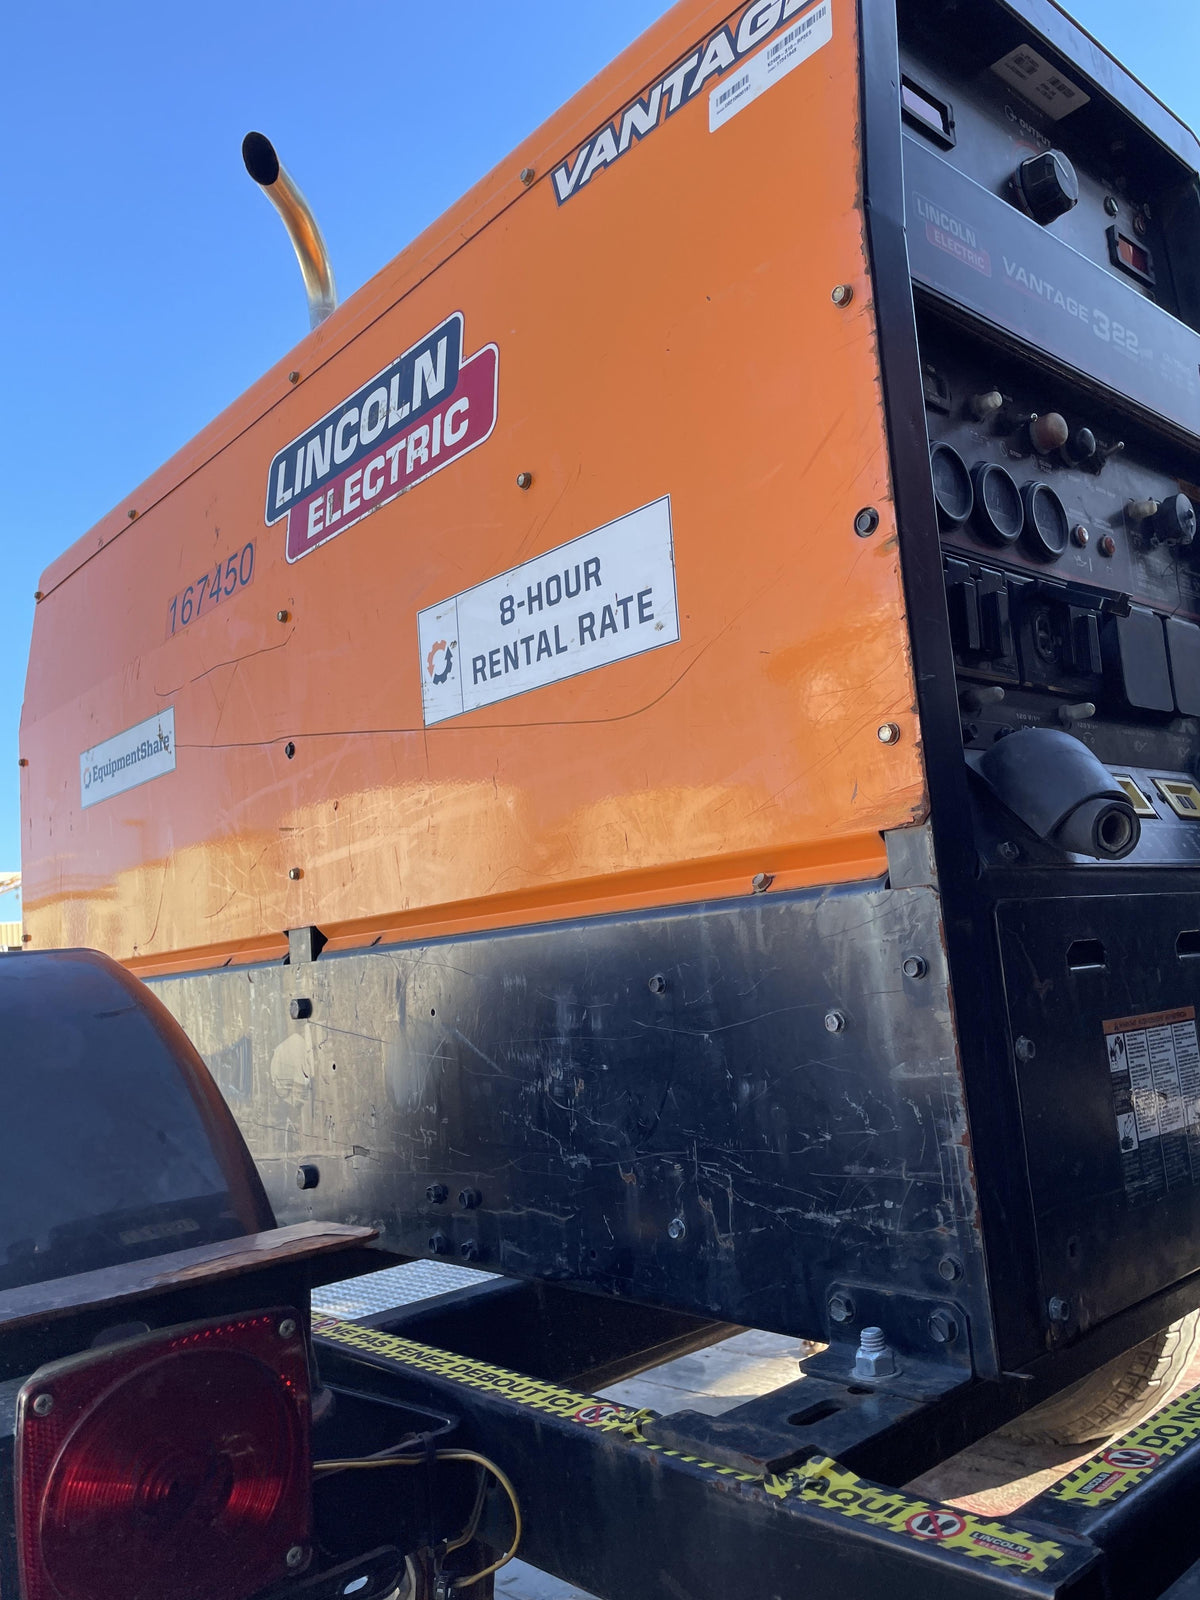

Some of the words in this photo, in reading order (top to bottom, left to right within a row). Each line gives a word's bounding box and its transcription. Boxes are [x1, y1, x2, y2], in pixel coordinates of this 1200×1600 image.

[1019, 118, 1052, 146] OUTPUT
[915, 198, 977, 248] LINCOLN
[934, 231, 985, 269] ELECTRIC
[1002, 255, 1089, 324] VANTAGE
[1092, 308, 1139, 355] 322
[275, 336, 448, 509] LINCOLN
[307, 397, 470, 540] ELECTRIC
[169, 542, 254, 634] 167450
[499, 556, 602, 626] 8-HOUR
[472, 624, 568, 685] RENTAL
[578, 587, 655, 645] RATE
[92, 735, 170, 784] EquipmentShare
[329, 1323, 348, 1339] NE
[353, 1330, 393, 1348] PAS
[391, 1343, 449, 1368] TENEZ
[450, 1363, 544, 1402] DEBOUT
[546, 1394, 579, 1411] ICI
[1137, 1424, 1184, 1449] DO
[1079, 1472, 1111, 1493] LINCOLN
[972, 1531, 1028, 1554] LINCOLN
[977, 1540, 1028, 1559] ELECTRIC
